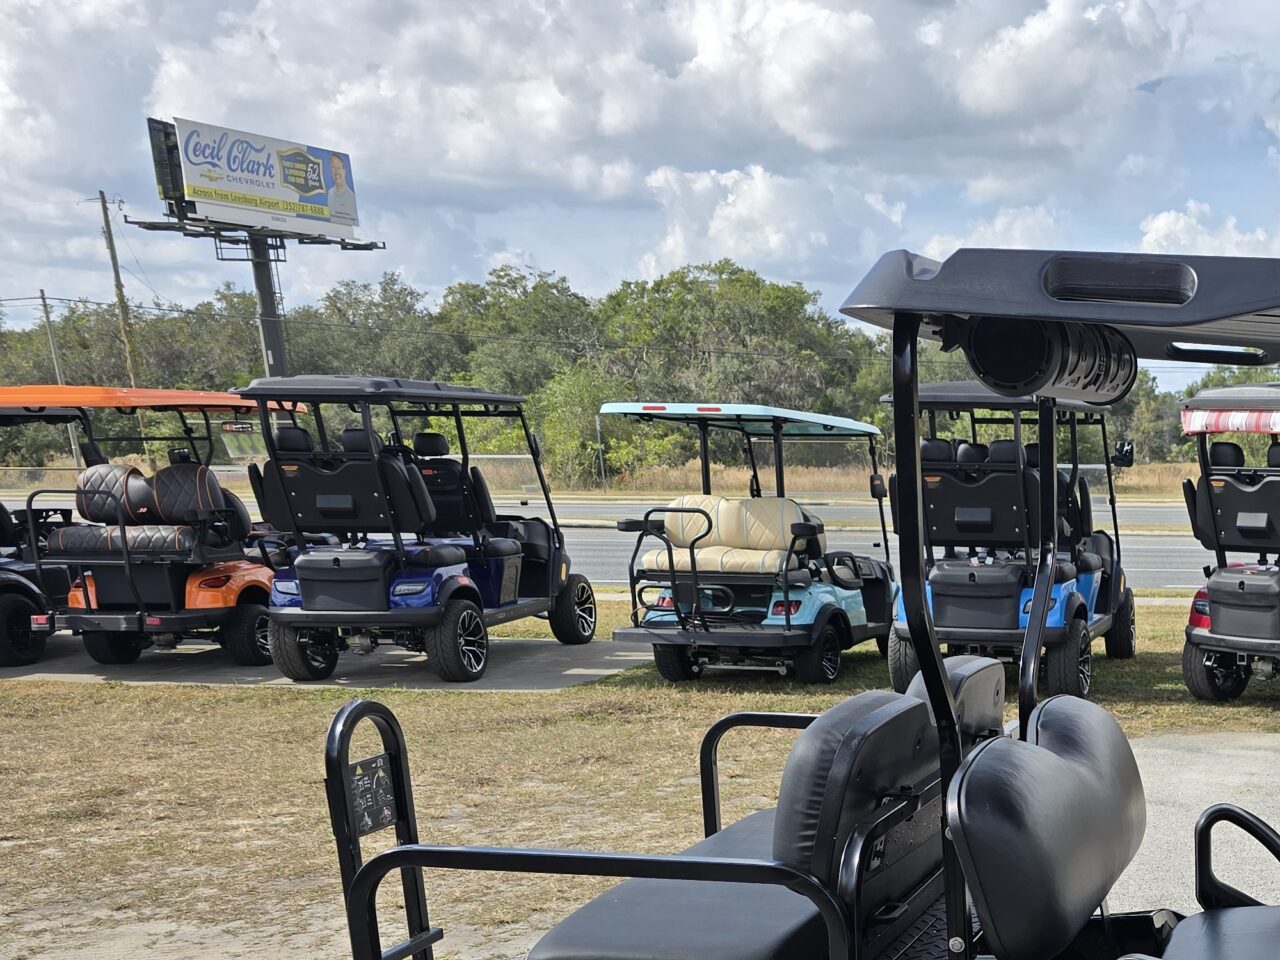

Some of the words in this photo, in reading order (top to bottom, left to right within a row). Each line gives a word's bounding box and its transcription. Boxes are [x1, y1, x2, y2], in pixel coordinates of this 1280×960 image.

[184, 129, 228, 169] Cecil
[227, 139, 275, 178] Clark
[226, 174, 276, 189] CHEVROLET
[307, 163, 319, 181] 52
[192, 186, 214, 198] Across
[214, 190, 230, 200] from
[230, 193, 258, 207] Leesburg
[259, 198, 281, 209] Airport
